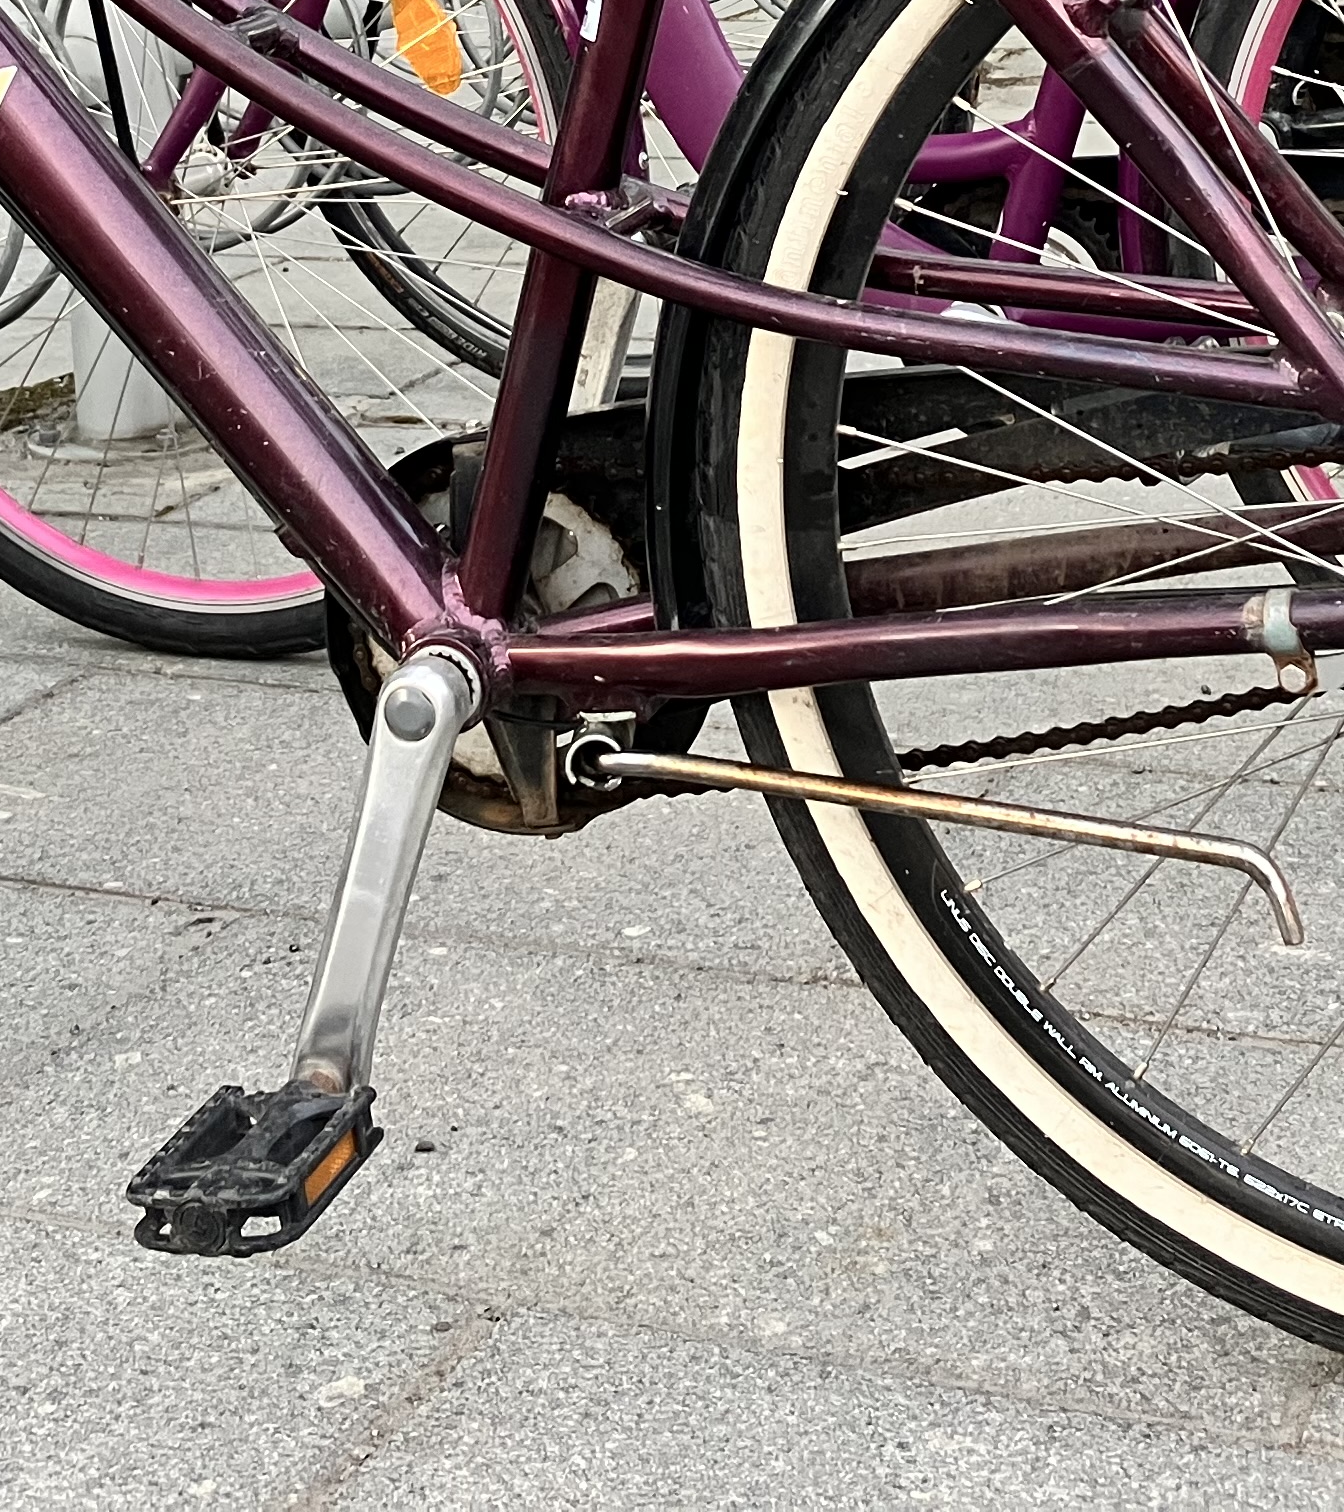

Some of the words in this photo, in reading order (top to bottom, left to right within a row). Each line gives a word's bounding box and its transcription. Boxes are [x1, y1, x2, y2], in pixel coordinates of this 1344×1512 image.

[968, 932, 997, 967] DISC
[993, 965, 1044, 1023] DOUBLE
[1043, 1020, 1077, 1060] WALL
[1104, 1081, 1178, 1140] ALUMINIUM
